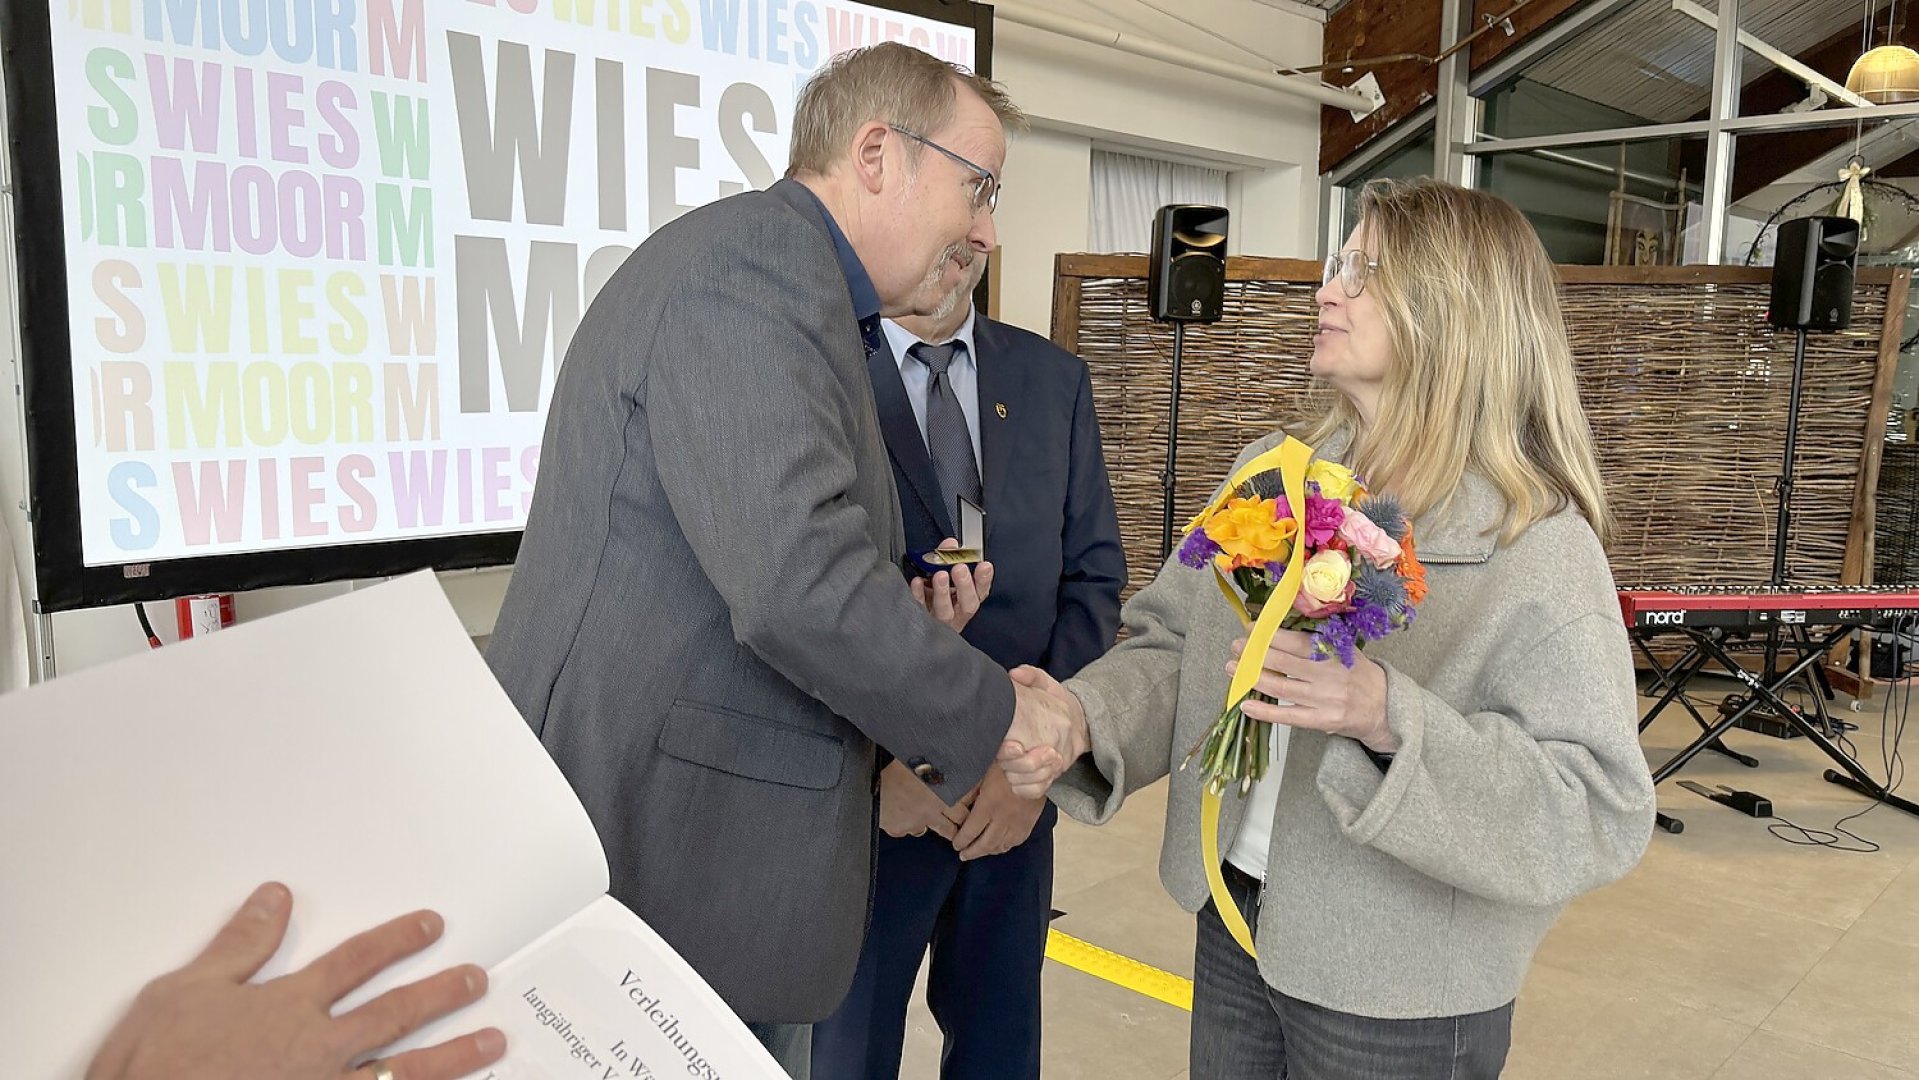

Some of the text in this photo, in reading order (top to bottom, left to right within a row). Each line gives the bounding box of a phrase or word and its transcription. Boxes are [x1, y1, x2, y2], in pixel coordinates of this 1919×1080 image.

[699, 0, 818, 70] WIES
[85, 47, 430, 180] S WIES W
[446, 30, 777, 233] WIES
[151, 155, 366, 261] MOOR
[376, 183, 435, 268] M
[92, 259, 436, 356] S WIES W
[90, 361, 440, 452] R MOOR M
[107, 461, 160, 551] S
[171, 454, 377, 546] WIES
[1646, 609, 1687, 624] nord
[523, 987, 601, 1068] langjähriger
[611, 1040, 628, 1062] In
[619, 969, 720, 1080] Verleihungs
